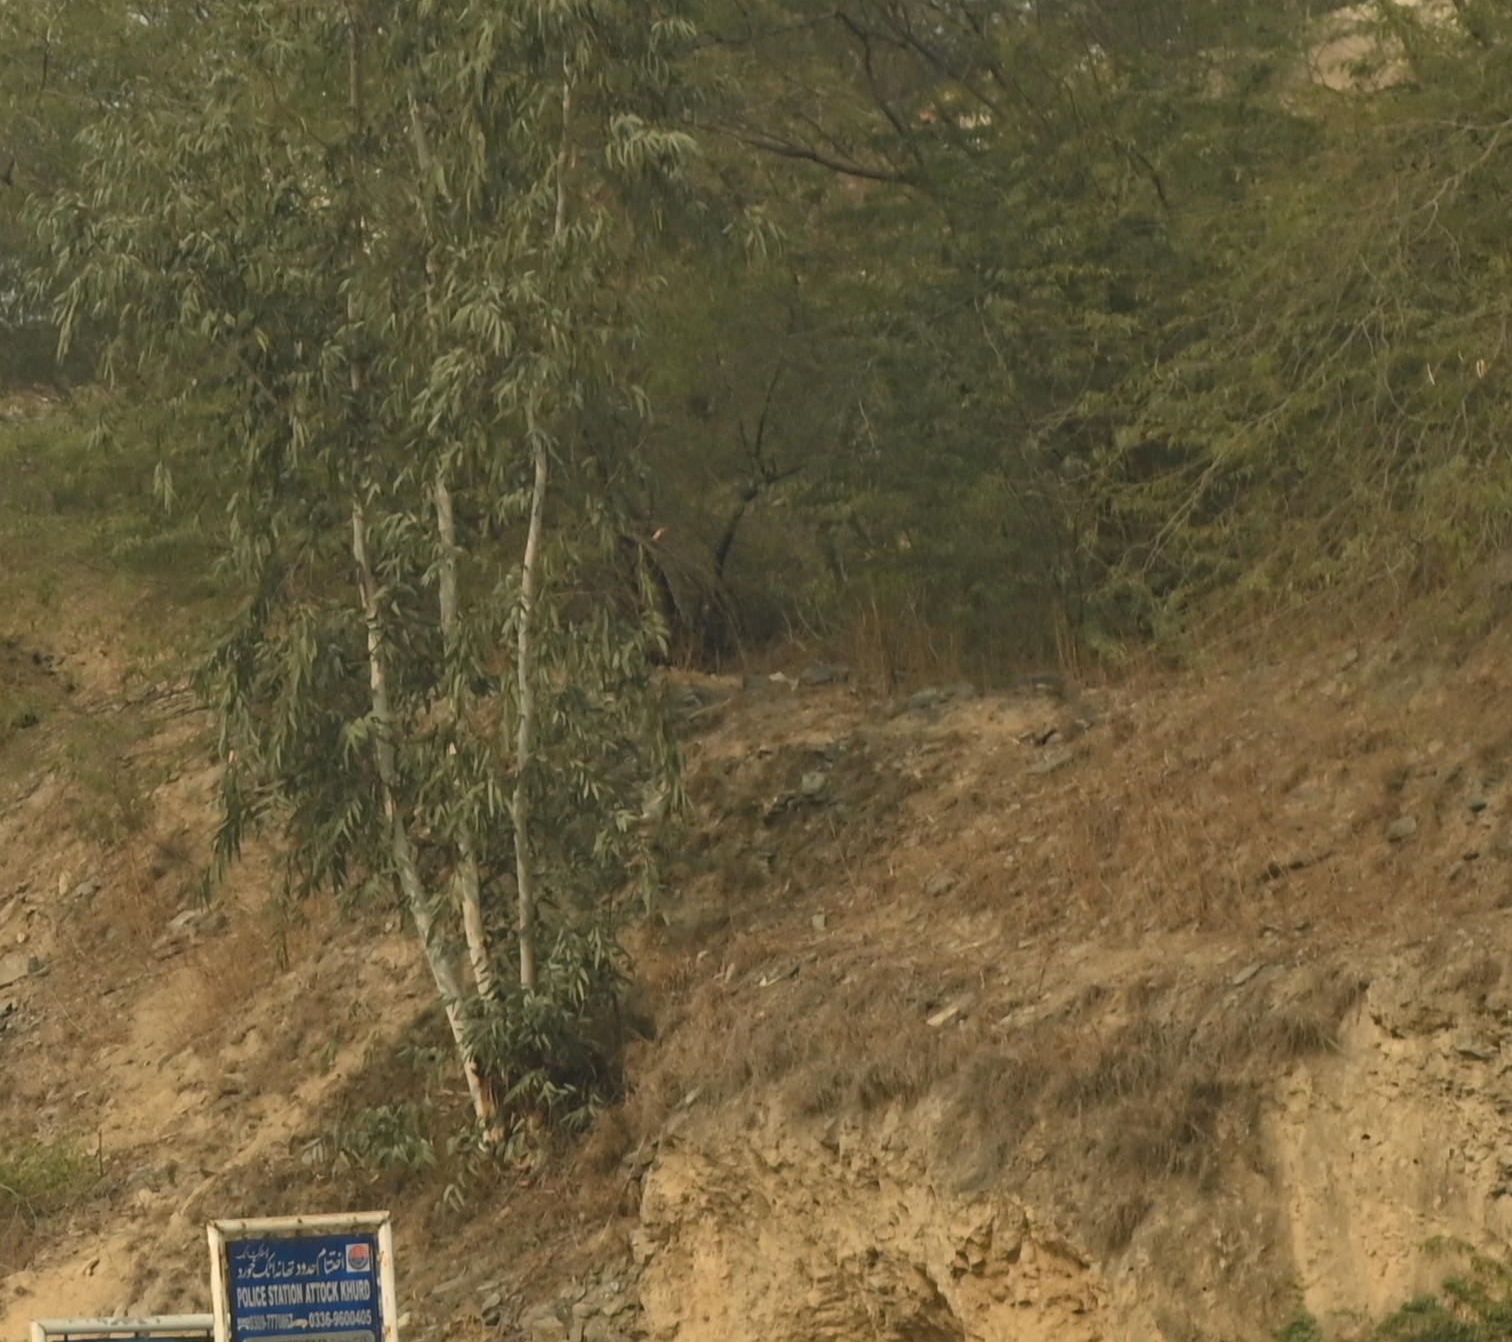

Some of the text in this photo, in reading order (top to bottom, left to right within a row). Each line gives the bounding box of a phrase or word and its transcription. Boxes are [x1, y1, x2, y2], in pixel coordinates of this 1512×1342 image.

[237, 1279, 370, 1308] POLICE STATION ATTOCK KHURD
[308, 1310, 372, 1328] 0336-9600405
